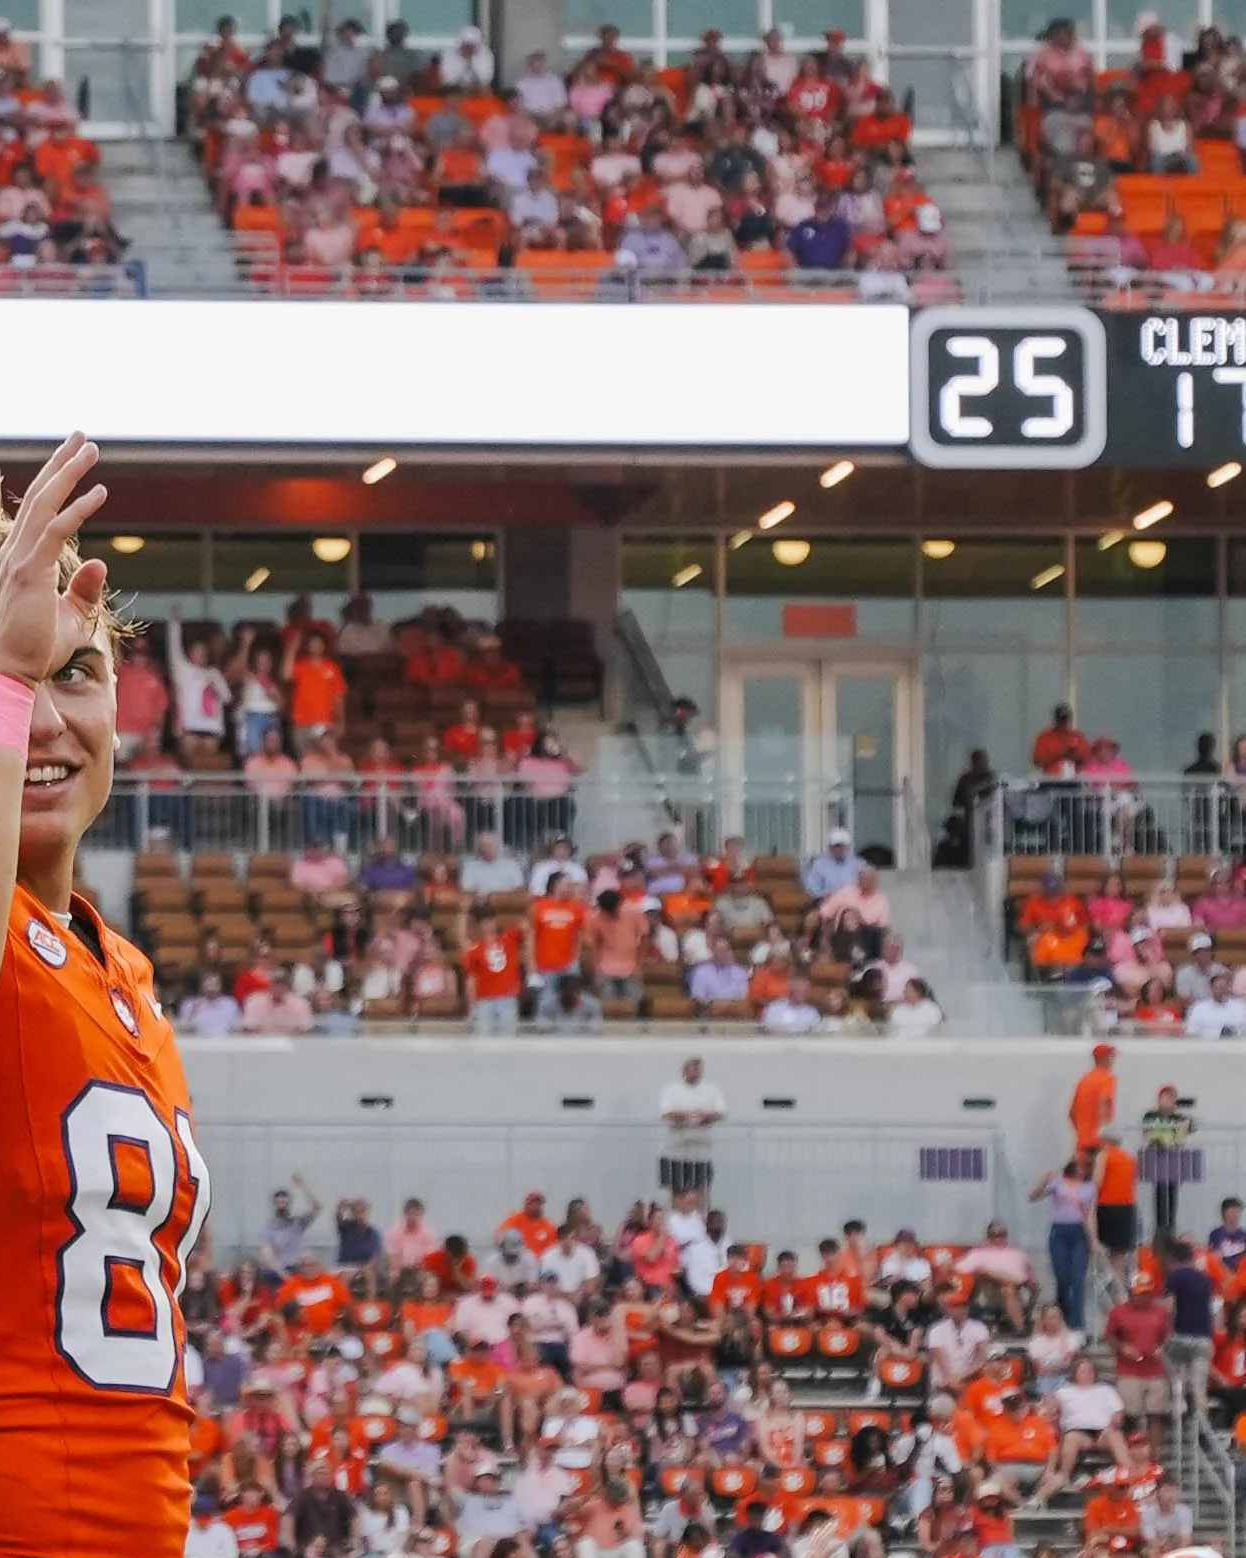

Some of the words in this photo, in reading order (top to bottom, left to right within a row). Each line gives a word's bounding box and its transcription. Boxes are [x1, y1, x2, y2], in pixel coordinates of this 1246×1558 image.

[939, 336, 1074, 438] 25
[1140, 316, 1246, 366] CLEM
[57, 1079, 211, 1395] 81
